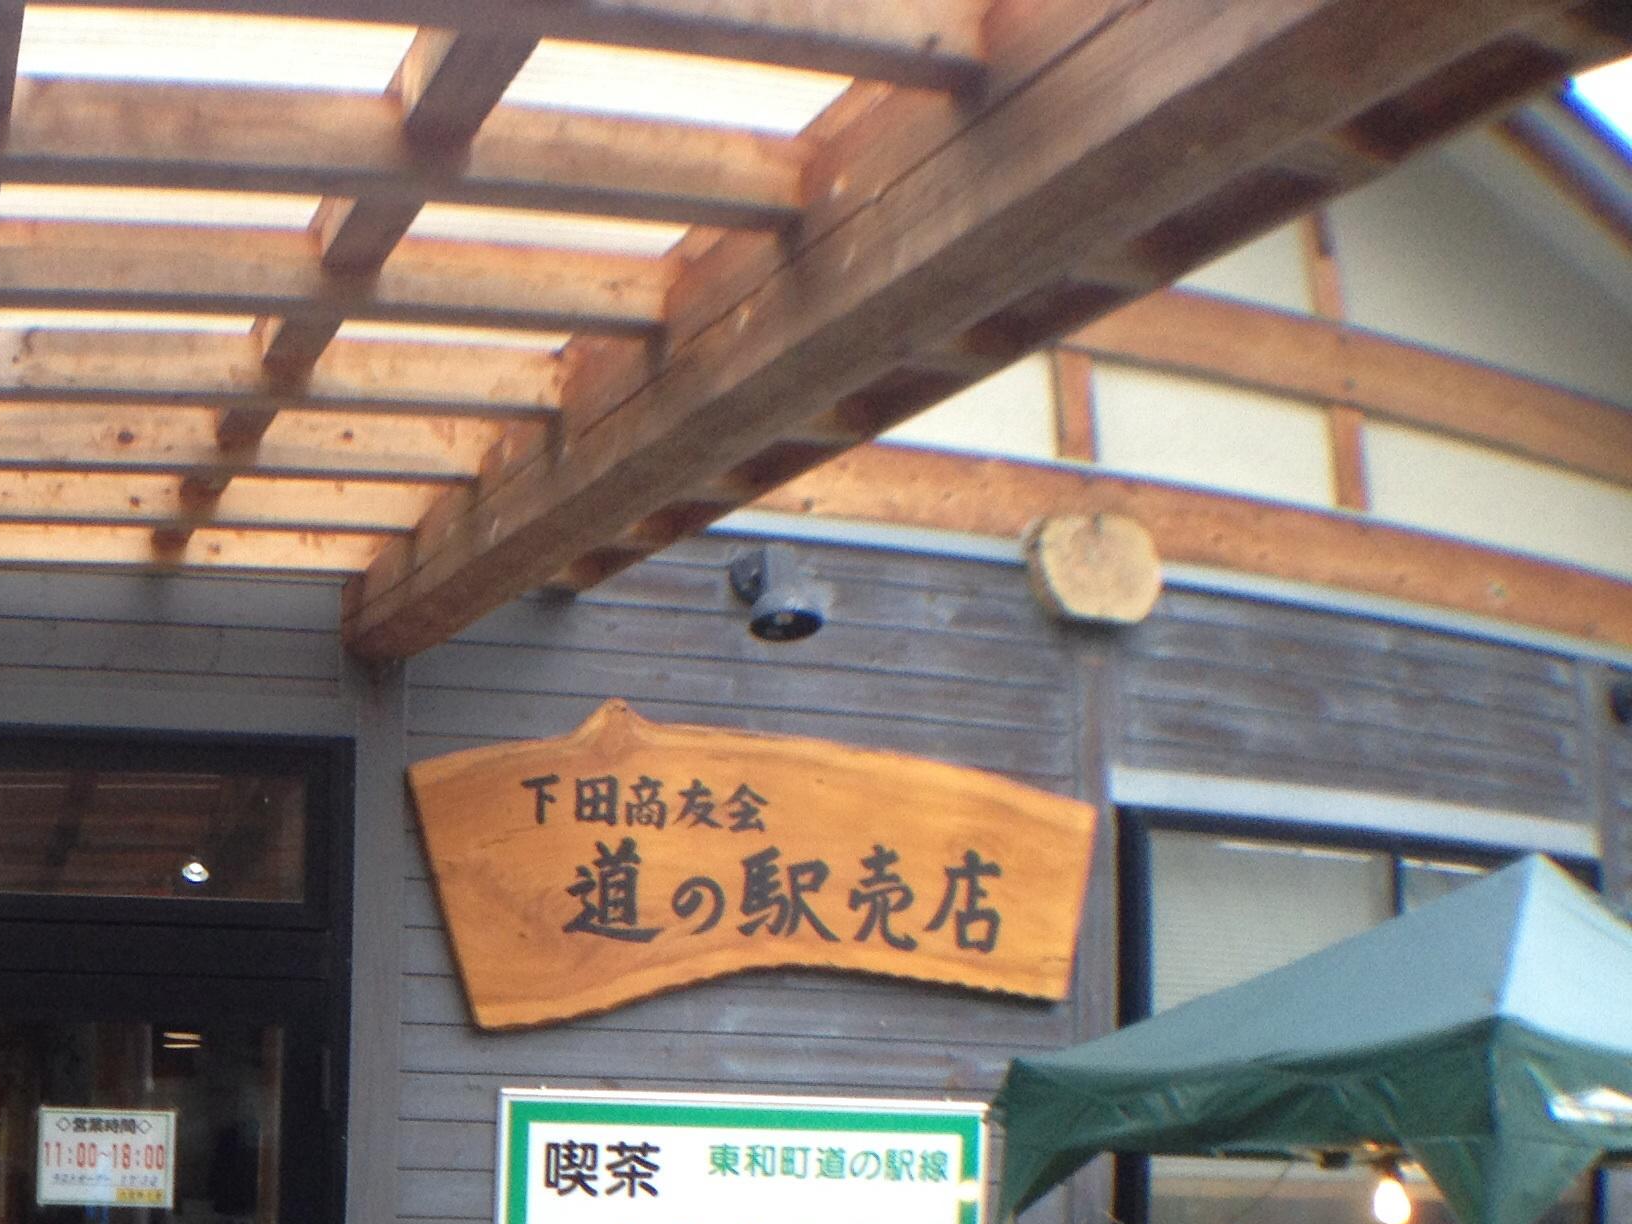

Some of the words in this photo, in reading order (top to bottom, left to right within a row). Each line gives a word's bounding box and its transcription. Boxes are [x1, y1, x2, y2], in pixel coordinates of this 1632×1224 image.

[521, 774, 769, 833] 下田商友会
[562, 838, 1003, 954] 道の駅売店
[543, 1141, 661, 1198] 喫茶
[708, 1143, 952, 1183] 東和町道の駅線
